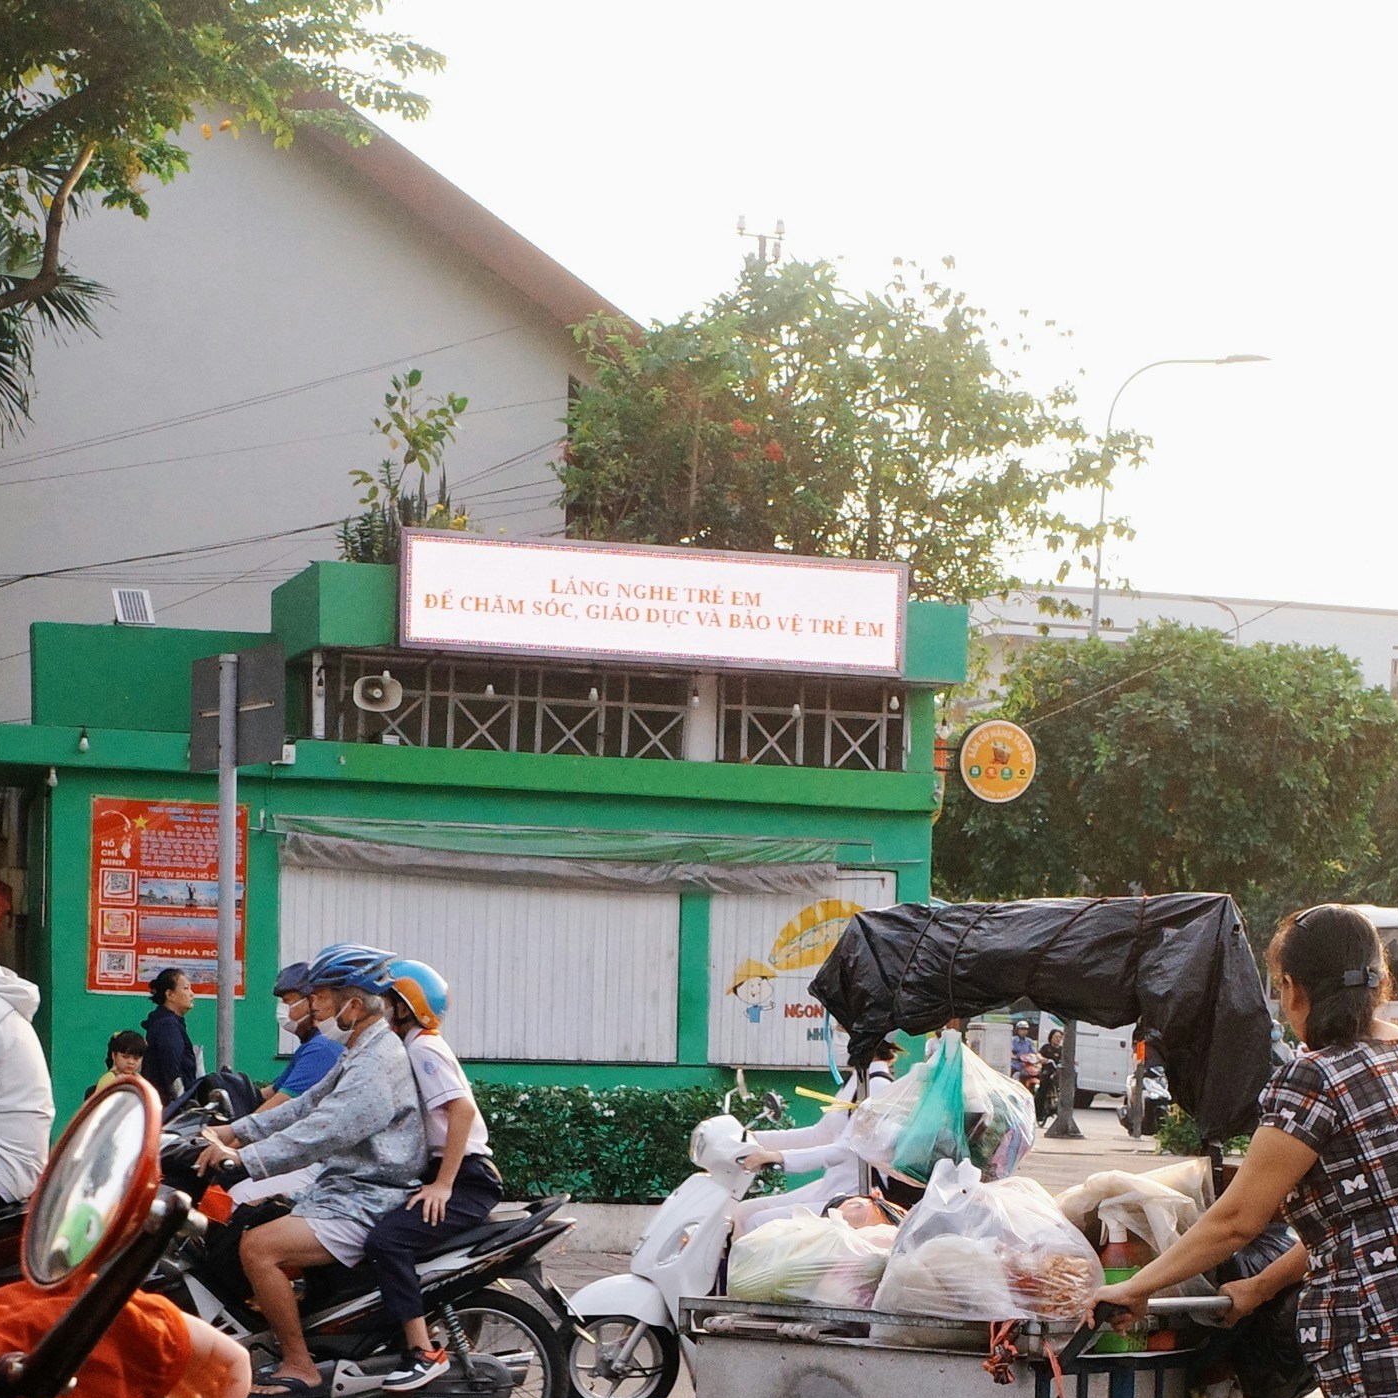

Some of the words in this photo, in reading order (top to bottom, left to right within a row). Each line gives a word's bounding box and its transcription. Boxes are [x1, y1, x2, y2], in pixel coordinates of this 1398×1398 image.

[617, 582, 678, 602] NGHE
[683, 583, 725, 605] TRẺ
[731, 590, 762, 607] EM
[423, 588, 454, 610] ĐỂ
[460, 594, 525, 615] CHĂM
[531, 598, 579, 621] SÓC,
[585, 602, 641, 622] GIÁO
[646, 607, 690, 628] DỤC
[696, 608, 723, 628] VÀ
[728, 609, 771, 630] BẢO
[777, 613, 804, 636] VỆ
[808, 615, 848, 636] TRẺ
[853, 620, 885, 638] EM
[100, 858, 126, 867] MINH
[784, 1003, 824, 1018] NGON
[1340, 1173, 1370, 1196] M
[1369, 1246, 1397, 1268] M
